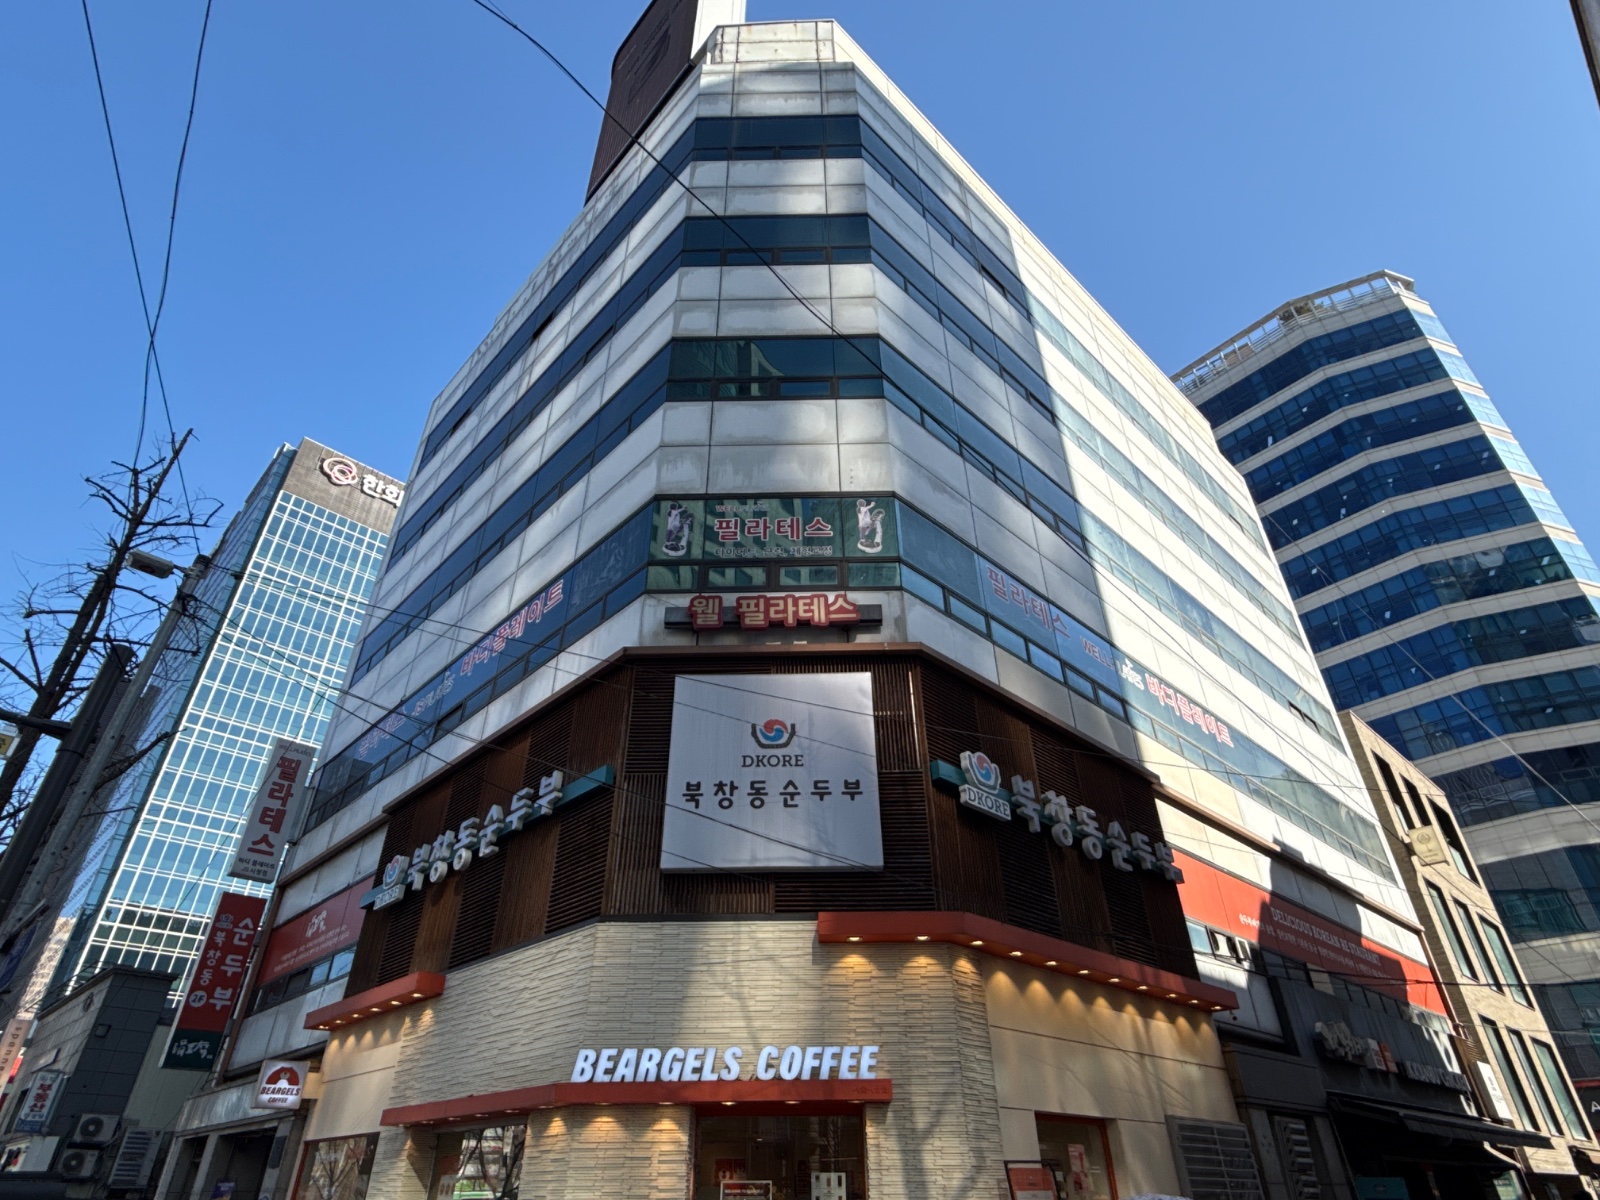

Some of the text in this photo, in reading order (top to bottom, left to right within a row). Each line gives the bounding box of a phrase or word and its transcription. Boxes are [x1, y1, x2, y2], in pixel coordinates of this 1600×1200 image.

[714, 517, 834, 542] 필라테스
[461, 579, 564, 676] 바디플레이트
[690, 596, 858, 627] 웰 필라테스
[986, 565, 1071, 639] 필라테스
[1145, 673, 1234, 748] 바디플레이트
[741, 754, 805, 768] DKORE
[247, 756, 302, 857] 필라테스
[681, 779, 863, 810] 북창동순두부
[966, 786, 1010, 818] DKORE
[407, 770, 564, 892] 북창동순두부
[1011, 774, 1185, 884] 북창동순두부
[199, 930, 227, 986] 북창동
[209, 917, 255, 1011] 순두부
[191, 993, 206, 1004] 2F
[570, 1045, 880, 1082] BEARGELS COFFEE
[261, 1086, 301, 1096] BEARGELS
